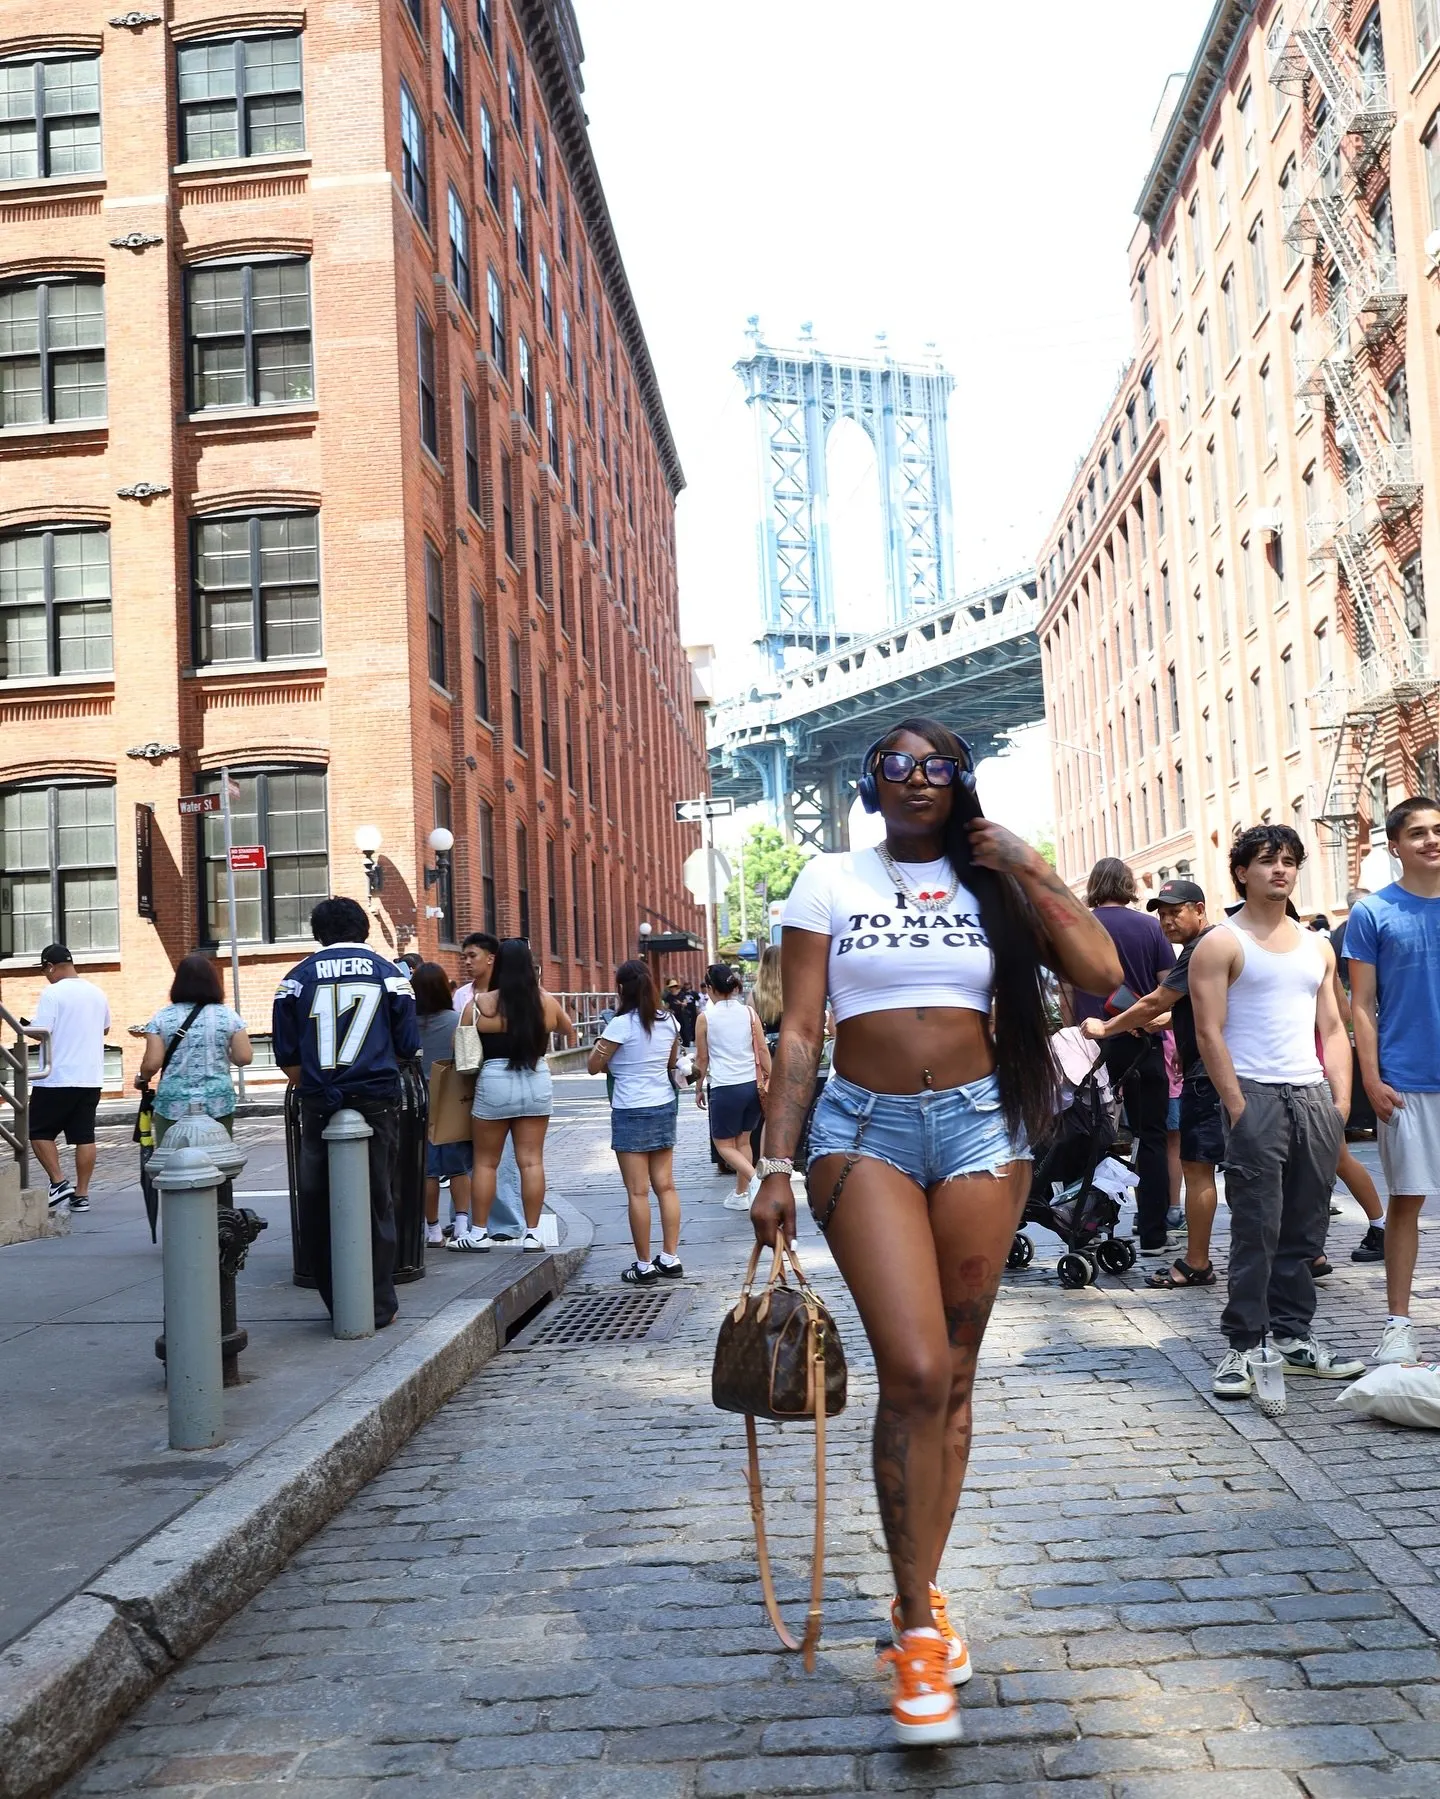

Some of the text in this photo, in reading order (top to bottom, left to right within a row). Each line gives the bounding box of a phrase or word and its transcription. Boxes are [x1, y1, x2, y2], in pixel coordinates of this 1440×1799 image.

[179, 799, 213, 813] Water St
[894, 892, 908, 910] I
[849, 913, 892, 932] TO
[836, 932, 991, 956] BOYS CR
[315, 957, 374, 979] RIVERS
[309, 982, 382, 1070] 17
